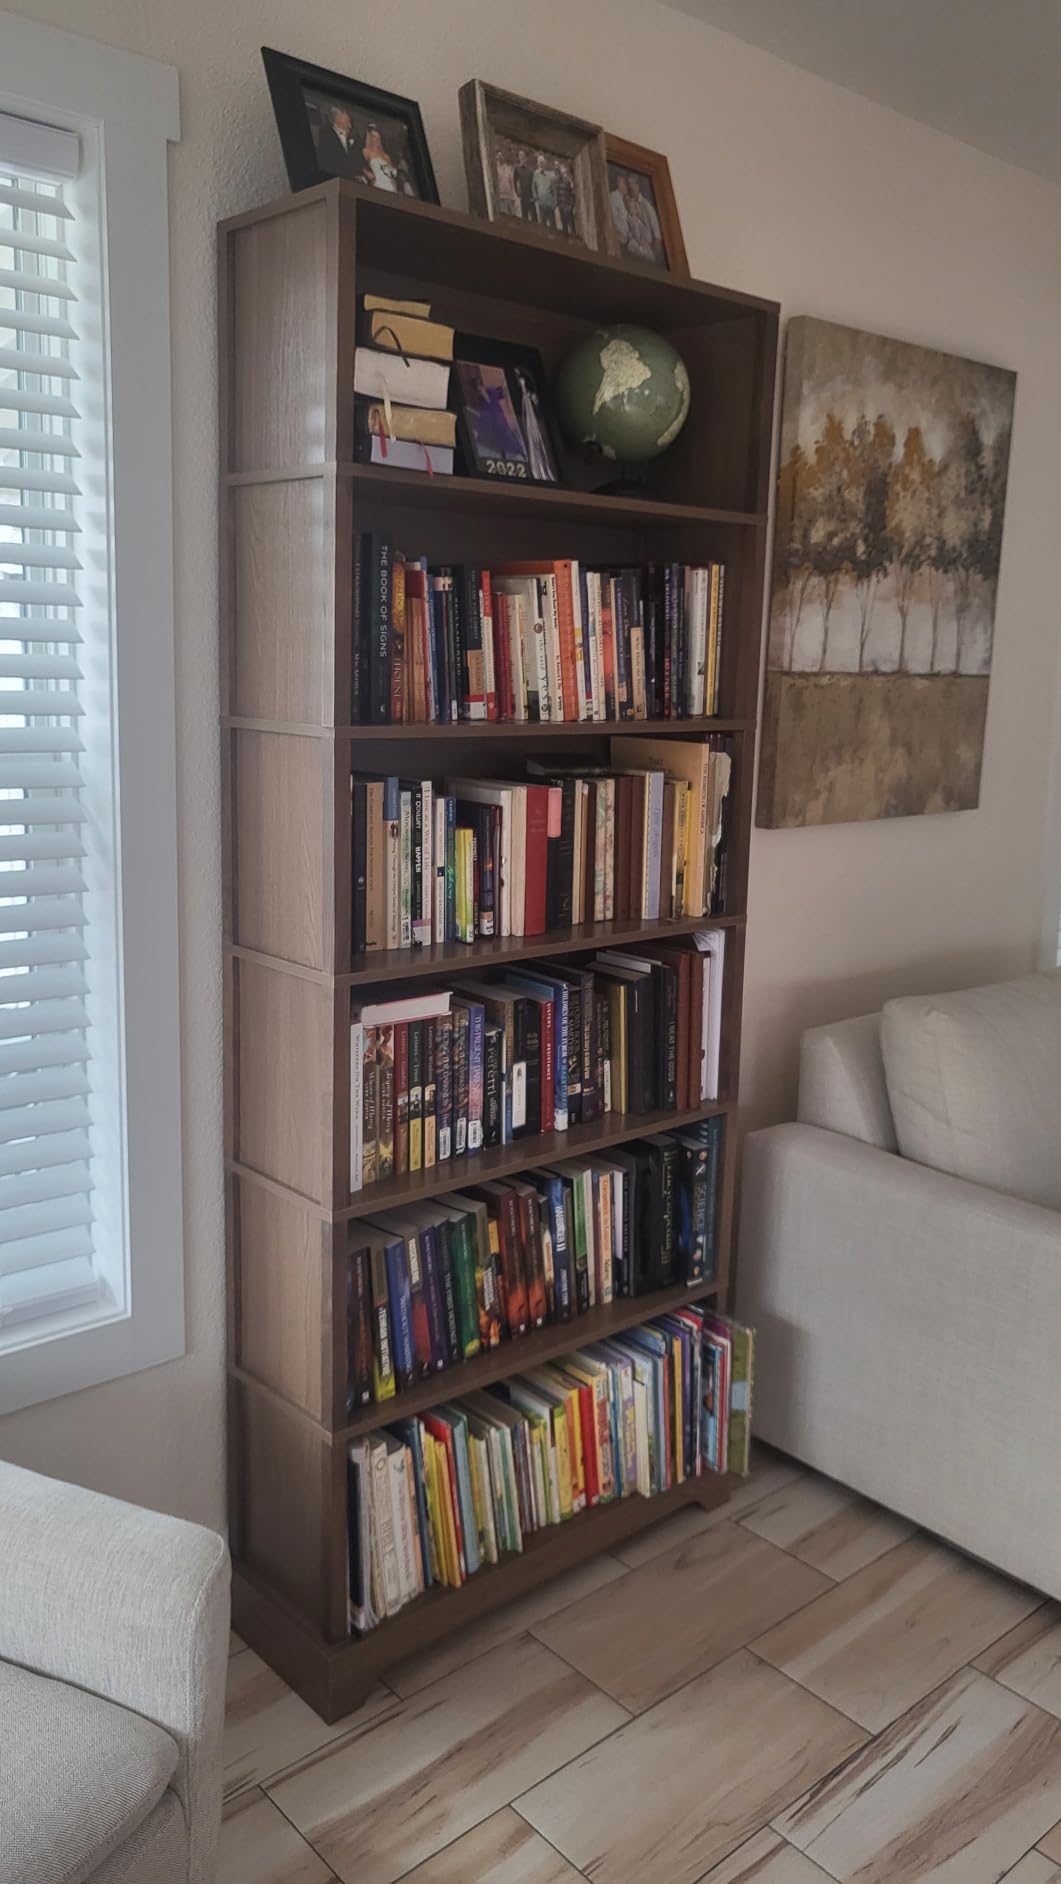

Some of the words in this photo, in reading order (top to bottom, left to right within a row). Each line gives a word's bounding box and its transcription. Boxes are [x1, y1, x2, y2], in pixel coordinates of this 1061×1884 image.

[486, 460, 527, 478] 2022
[380, 545, 389, 567] THE
[380, 571, 389, 603] BOOK
[380, 607, 389, 621] OF
[379, 625, 388, 657] SIGNS
[473, 1015, 482, 1031] THIS
[561, 1017, 568, 1025] OF
[473, 1032, 482, 1063] PRESENT
[442, 1071, 450, 1106] DARKNESS
